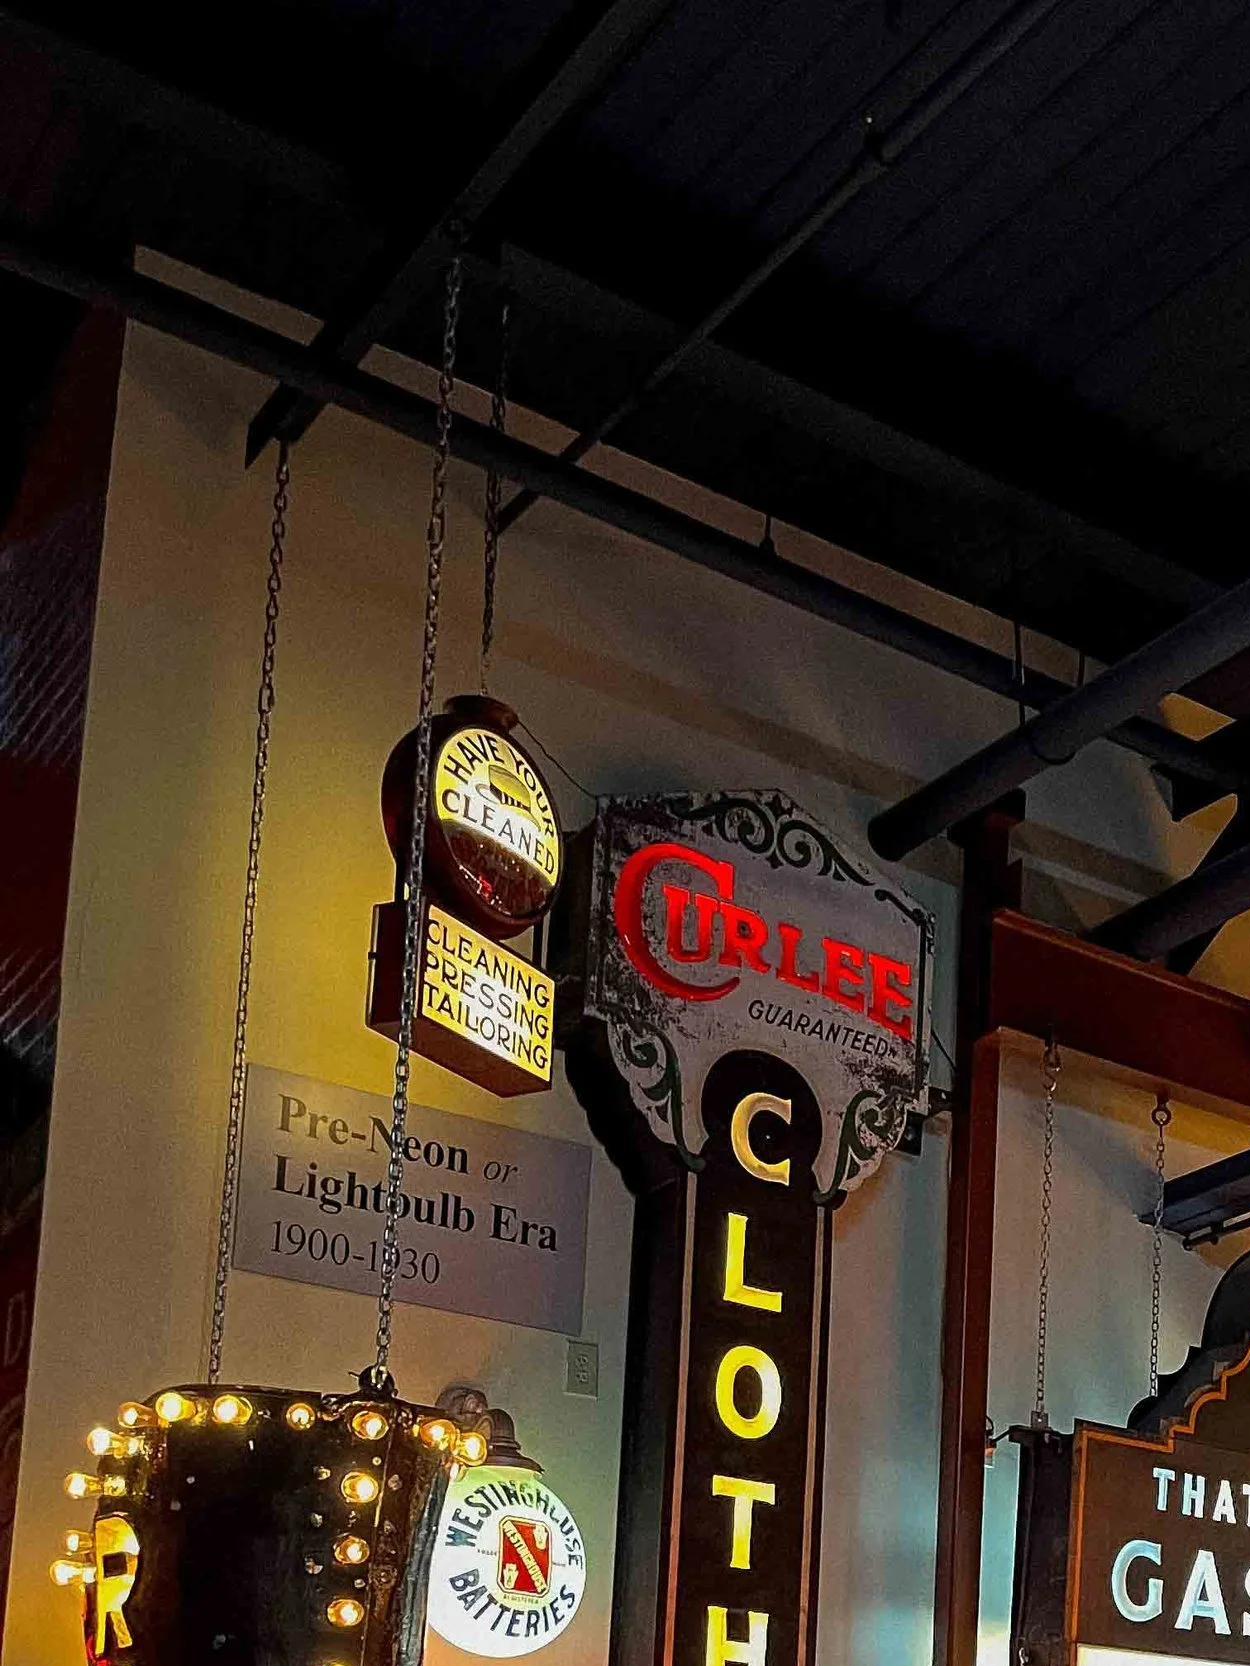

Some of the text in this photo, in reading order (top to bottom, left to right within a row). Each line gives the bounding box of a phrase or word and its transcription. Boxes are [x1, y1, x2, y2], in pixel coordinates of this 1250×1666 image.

[444, 736, 556, 837] HAVE YOUR
[441, 788, 556, 876] CLEANED
[427, 919, 550, 1008] CLEANING
[614, 842, 915, 1043] CURLEE
[424, 982, 548, 1070] TAILORING
[425, 951, 549, 1040] PRESSING
[748, 999, 889, 1058] GUARANTEED
[277, 1093, 519, 1185] Pre-Neon or
[489, 1203, 558, 1252] Era
[449, 1568, 575, 1638] BATTERIES
